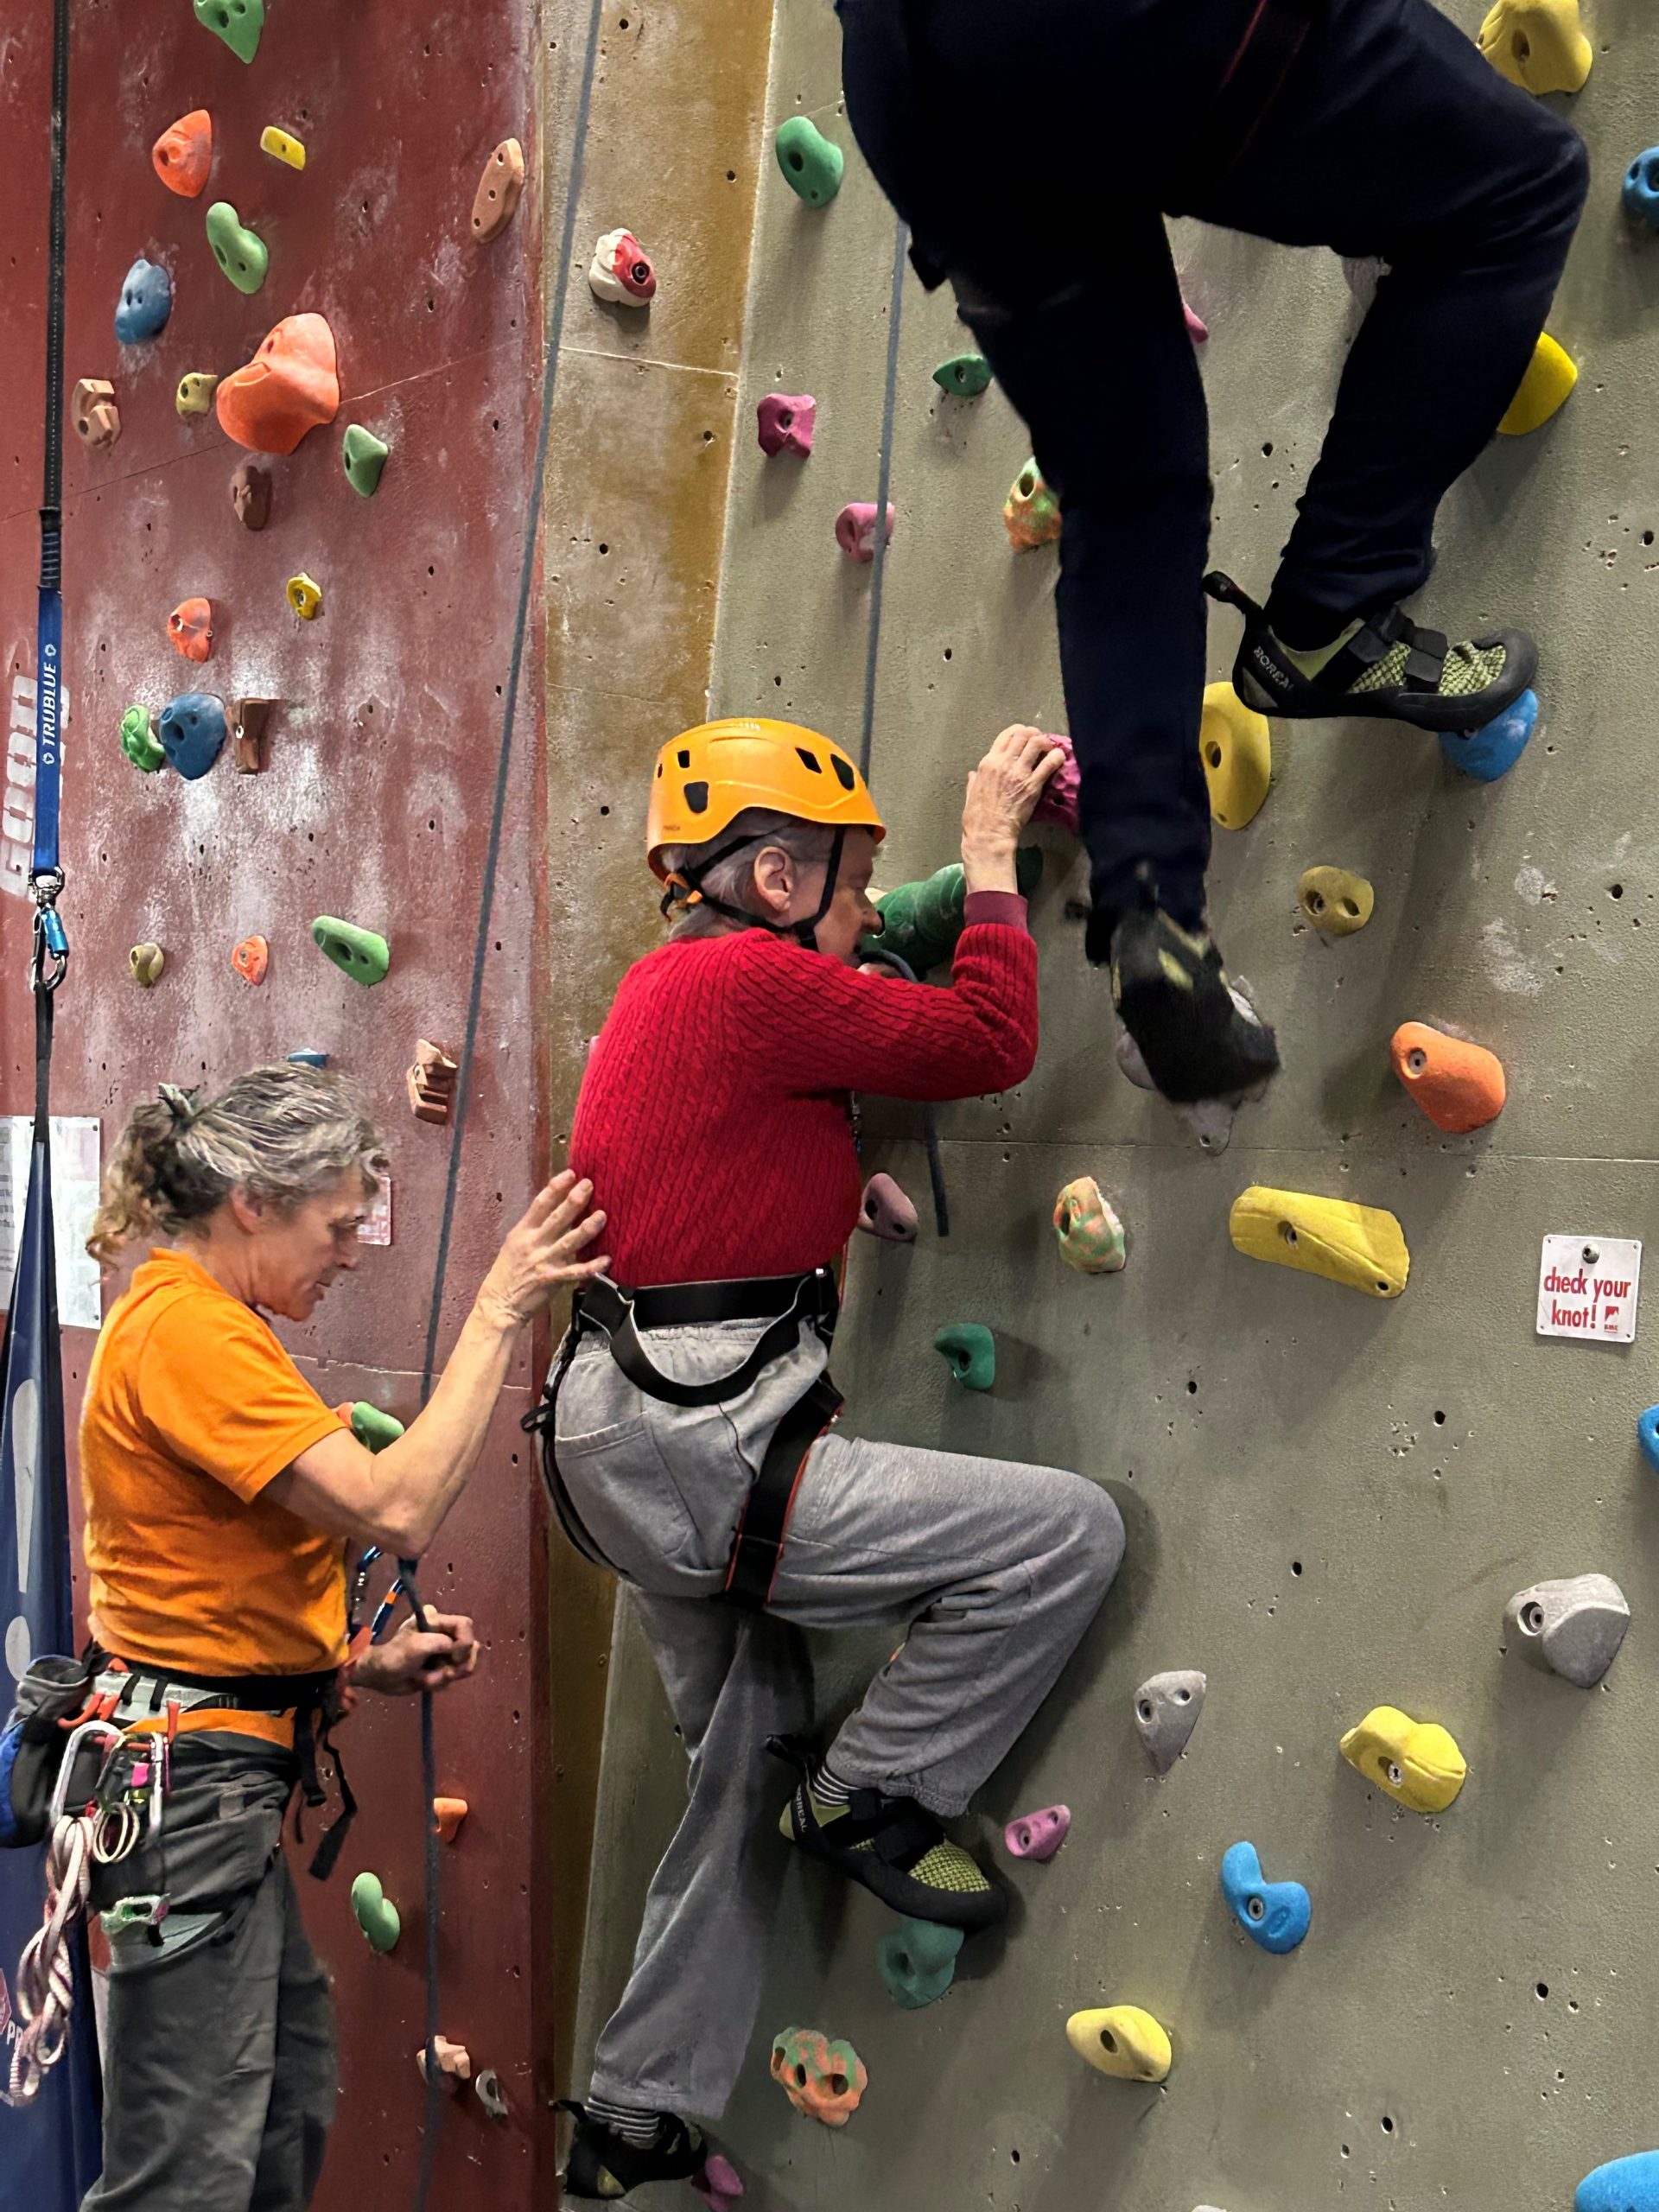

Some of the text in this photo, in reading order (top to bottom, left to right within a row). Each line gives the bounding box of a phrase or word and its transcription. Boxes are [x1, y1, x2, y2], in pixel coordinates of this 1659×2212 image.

[41, 661, 58, 747] TRUBLUE
[1543, 1266, 1632, 1304] check your
[1551, 1299, 1597, 1330] knot!
